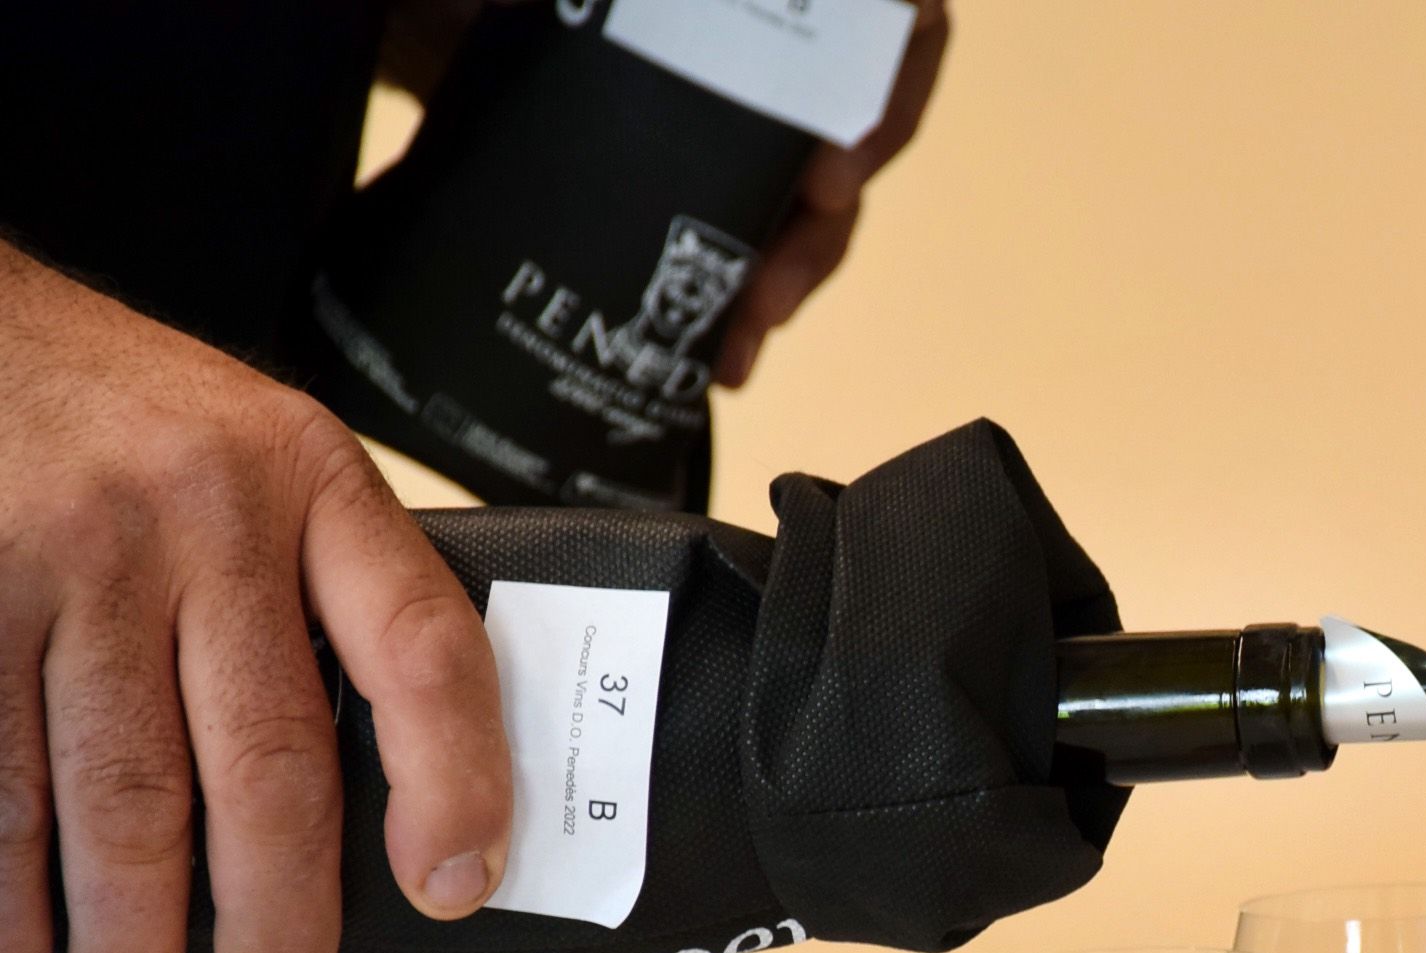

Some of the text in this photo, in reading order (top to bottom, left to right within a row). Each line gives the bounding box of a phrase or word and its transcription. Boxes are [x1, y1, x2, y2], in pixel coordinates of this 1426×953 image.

[577, 625, 597, 676] Concurs
[573, 680, 589, 708] Vins
[568, 711, 584, 743] D.O.
[588, 673, 629, 821] 37 B
[563, 804, 576, 836] 2022
